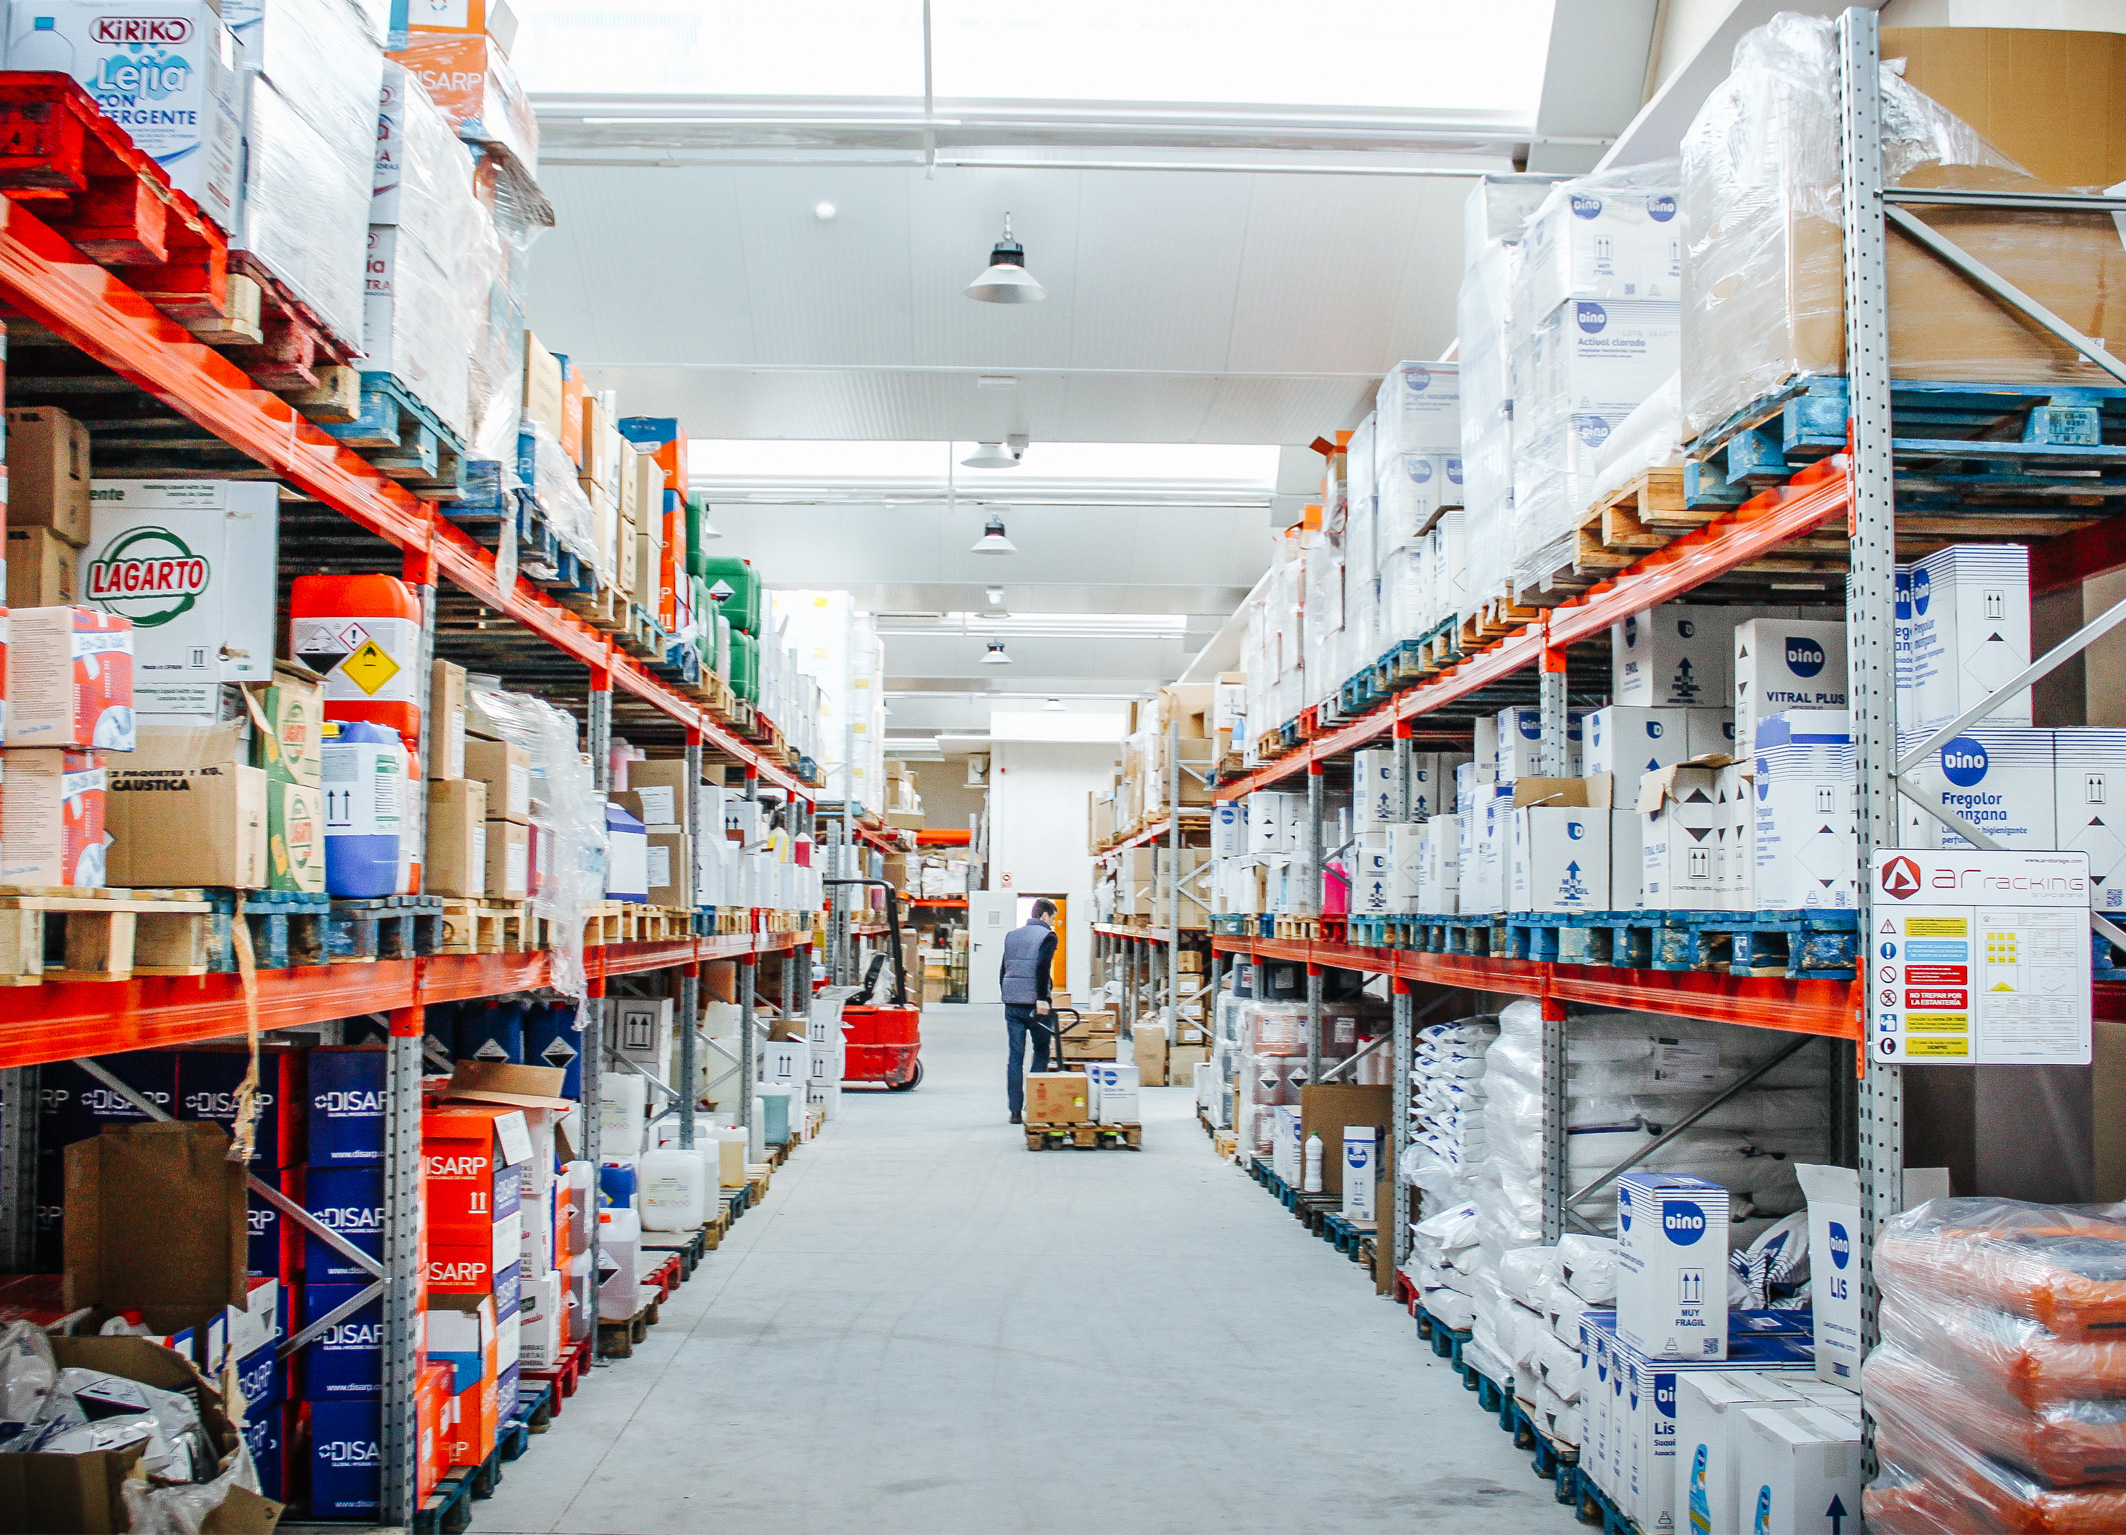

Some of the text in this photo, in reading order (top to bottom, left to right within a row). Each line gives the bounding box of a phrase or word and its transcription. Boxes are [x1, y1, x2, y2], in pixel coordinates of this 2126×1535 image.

[415, 69, 484, 92] ISARP
[96, 94, 136, 108] CON
[93, 559, 204, 593] LAGARTO
[1787, 648, 1823, 663] Dino
[1766, 690, 1846, 705] VITRAL PLUS
[1944, 751, 1985, 769] Dino
[121, 769, 185, 778] PAQUETES
[110, 778, 190, 792] CAUSTICA
[1941, 792, 2003, 809] Fregolor
[1950, 809, 2008, 825] anzana
[93, 1089, 171, 1110] DISP
[197, 1091, 274, 1112] DISAP
[426, 1155, 488, 1176] ISARP
[1665, 1213, 1704, 1230] Dino
[426, 1261, 488, 1281] ISARP
[1829, 1275, 1848, 1301] LIS
[1680, 1309, 1701, 1317] MUY
[1675, 1318, 1706, 1327] FRAGIL
[1654, 1421, 1676, 1435] Lis
